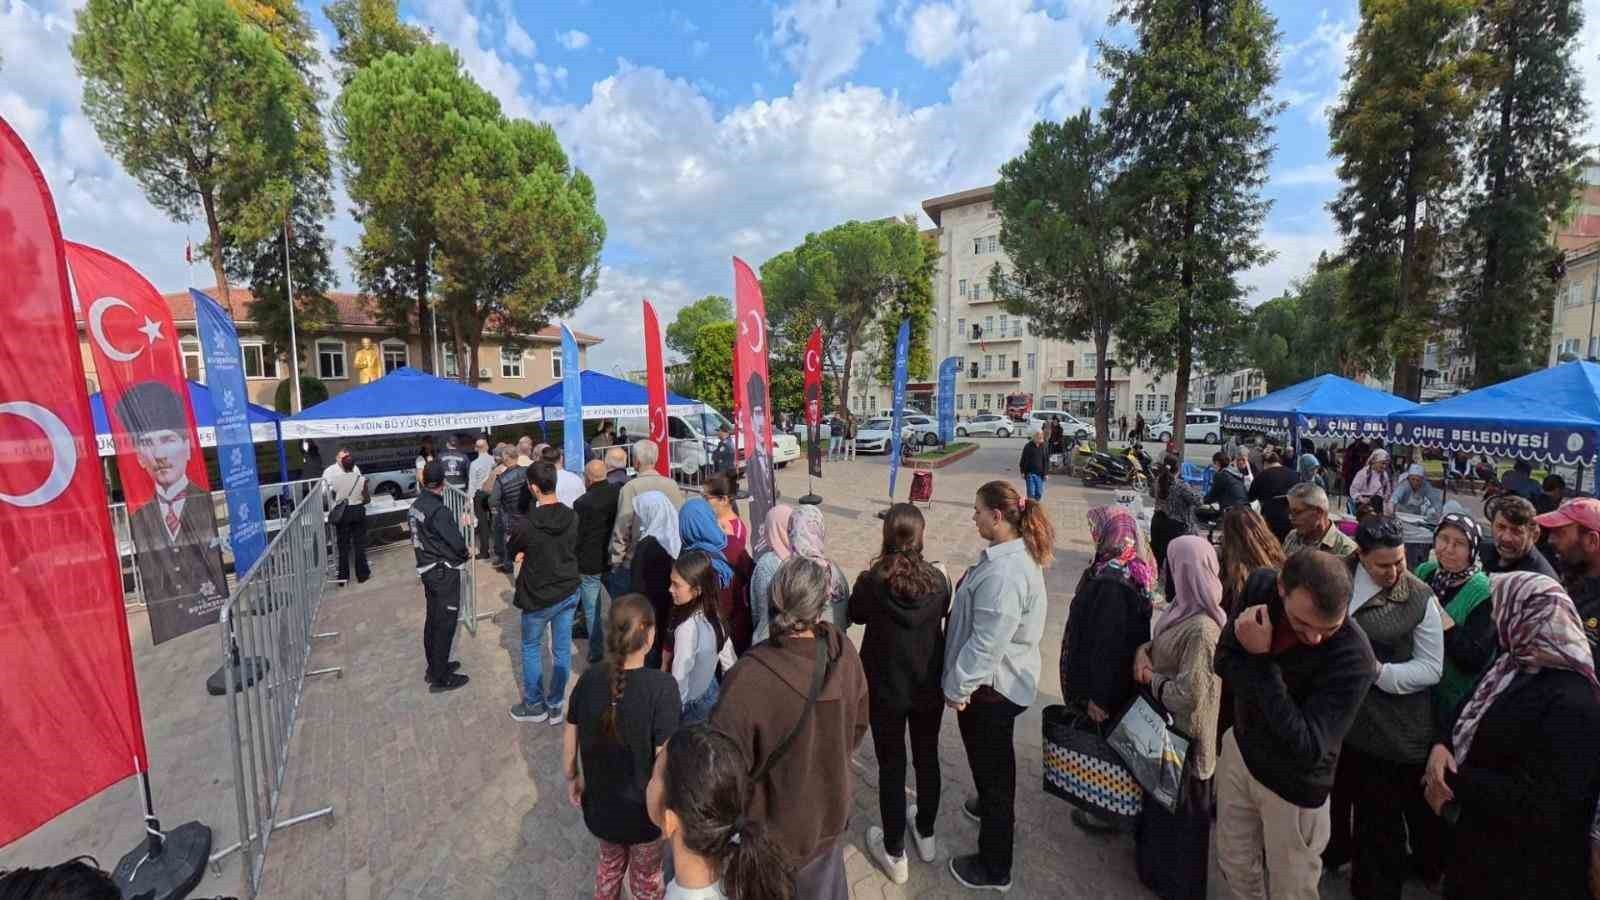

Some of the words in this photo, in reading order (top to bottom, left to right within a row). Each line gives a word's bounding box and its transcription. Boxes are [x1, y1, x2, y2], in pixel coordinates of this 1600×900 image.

[354, 421, 383, 433] AYDIN
[384, 415, 451, 430] BÜYÜKŞEHİR
[1328, 419, 1358, 432] ÇİNE
[1412, 424, 1445, 440] ÇİNE
[1451, 428, 1550, 449] BELEDİYESİ
